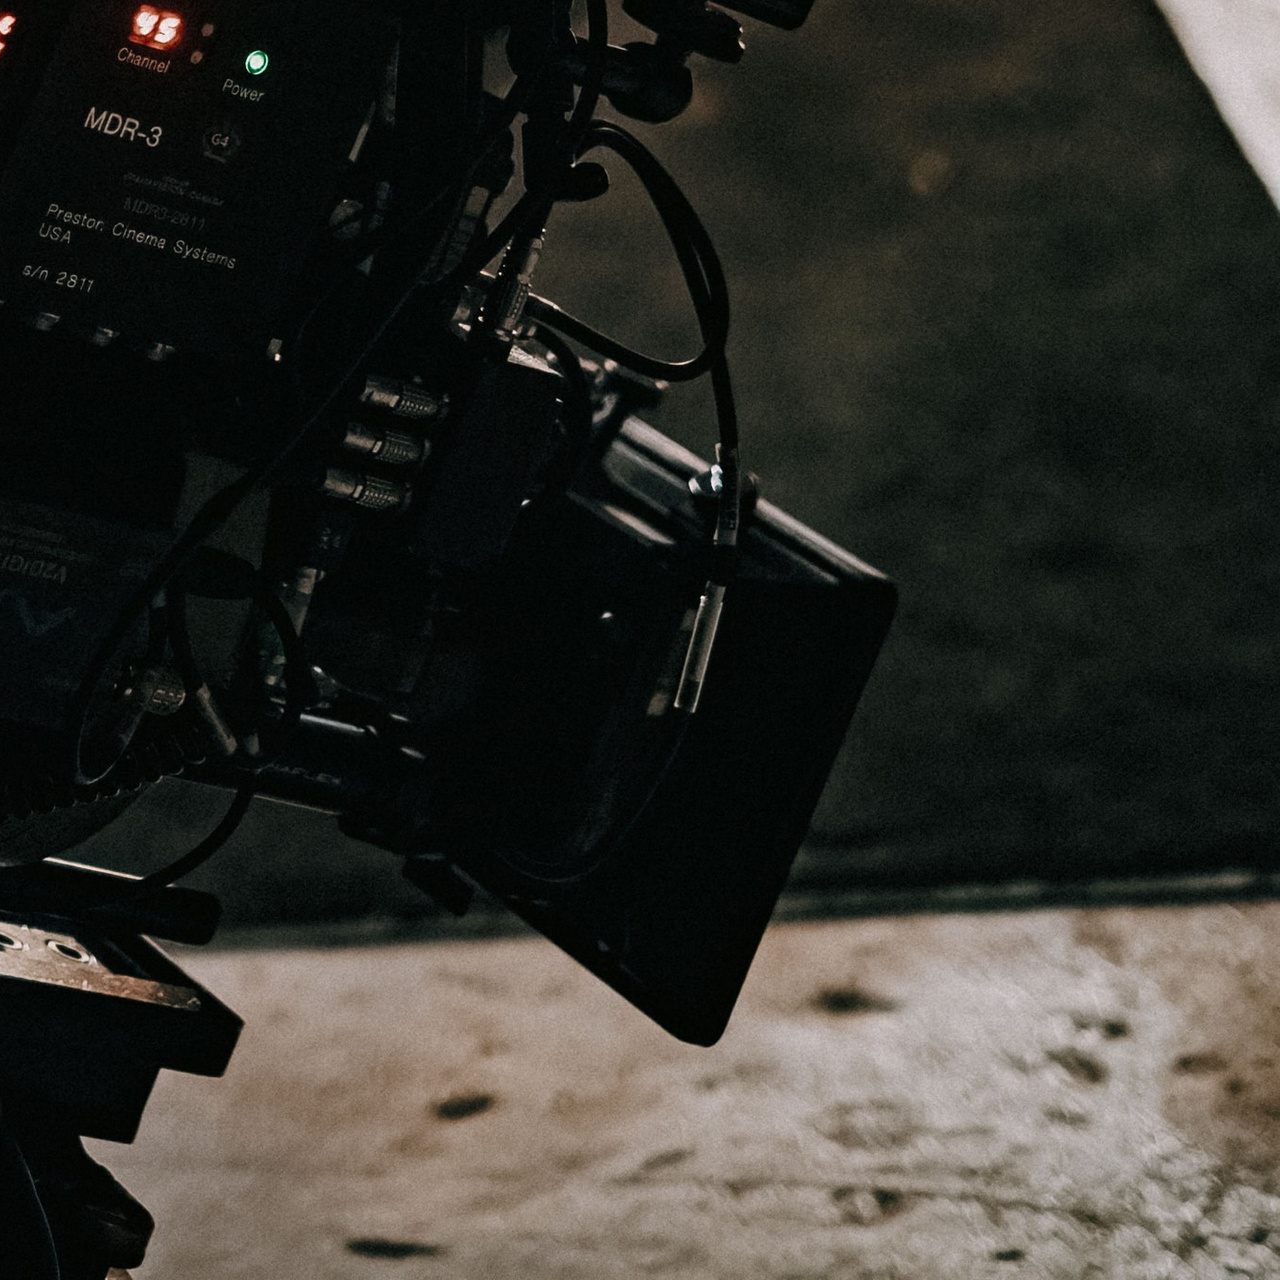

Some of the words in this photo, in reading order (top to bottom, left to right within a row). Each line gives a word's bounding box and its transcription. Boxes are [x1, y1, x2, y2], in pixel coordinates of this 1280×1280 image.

[117, 47, 171, 74] Channel
[222, 77, 266, 103] Power
[82, 106, 164, 149] MDR-3
[38, 222, 72, 244] USA
[111, 221, 168, 251] Cinema
[172, 238, 238, 271] Systems
[21, 263, 51, 283] s/n
[54, 270, 96, 294] 2811
